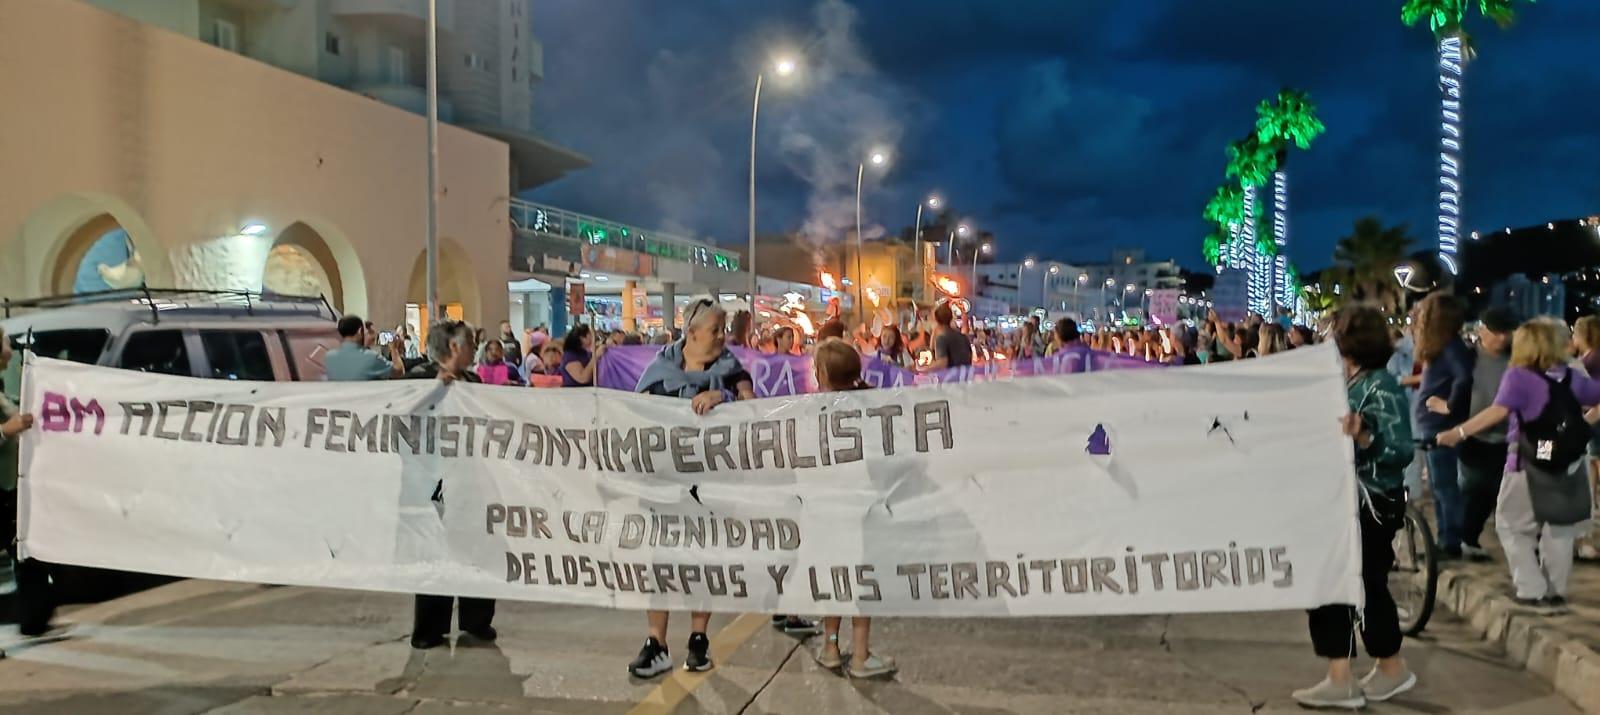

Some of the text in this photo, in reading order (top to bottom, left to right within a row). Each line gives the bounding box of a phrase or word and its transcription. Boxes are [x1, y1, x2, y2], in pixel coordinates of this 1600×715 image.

[118, 400, 286, 448] ACCION
[304, 410, 514, 459] FEMINISTA
[486, 503, 802, 551] POR LA DIGNIDAD
[505, 541, 1294, 601] DE LOS CUERPOS Y LOS TERRITORITORIOS
